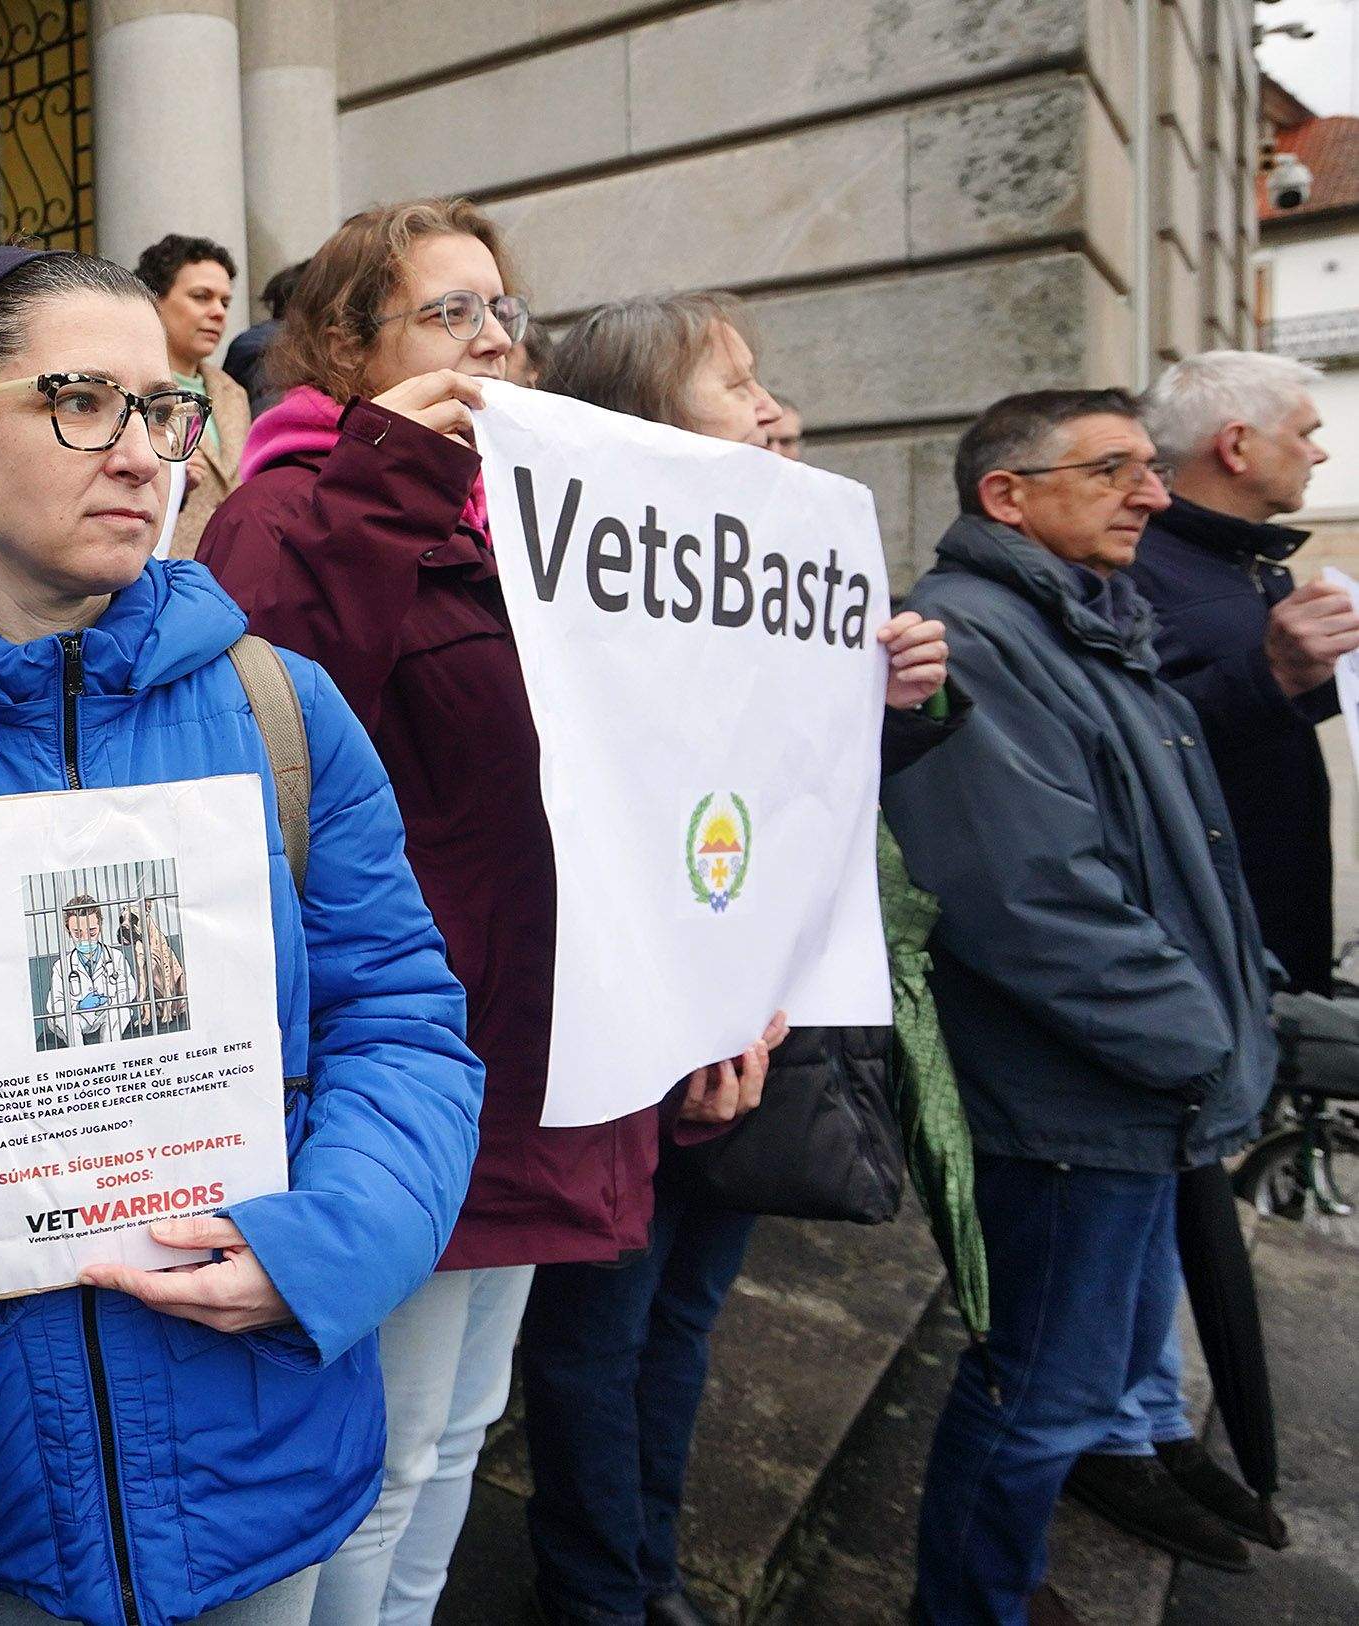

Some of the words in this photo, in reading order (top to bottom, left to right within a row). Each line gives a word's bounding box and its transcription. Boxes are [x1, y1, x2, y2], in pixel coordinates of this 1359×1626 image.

[513, 464, 872, 650] VetsBasta
[37, 1072, 48, 1081] ES
[55, 1063, 115, 1078] INDIGNANTE
[122, 1057, 152, 1068] TENER
[159, 1053, 179, 1063] QUE
[186, 1047, 217, 1059] ELEGIR
[223, 1041, 252, 1052] ENTRE
[32, 1085, 53, 1094] UNA
[55, 1081, 80, 1091] VIDA
[92, 1073, 127, 1085] SEGUIR
[130, 1071, 142, 1079] LA
[144, 1068, 164, 1077] LEY.
[37, 1097, 52, 1106] NO
[57, 1094, 69, 1103] ES
[74, 1087, 110, 1100] LÓGICO
[115, 1081, 146, 1092] TENER
[151, 1078, 171, 1088] QUE
[177, 1071, 213, 1084] BUSCAR
[218, 1064, 254, 1076] VACÍOS
[38, 1107, 64, 1118] PARA
[67, 1101, 99, 1113] PODER
[102, 1094, 143, 1107] EJERCER
[146, 1080, 230, 1100] CORRECTAMENTE.
[8, 1136, 28, 1146] QUÉ
[31, 1128, 77, 1143] ESTAMOS
[80, 1119, 132, 1134] JUGANDO?
[68, 1150, 144, 1172] SÍGUENOS
[147, 1147, 156, 1158] Y
[161, 1134, 245, 1156] COMPARTE,
[96, 1169, 153, 1189] SOMOS:
[25, 1182, 224, 1233] VETWARRIORS
